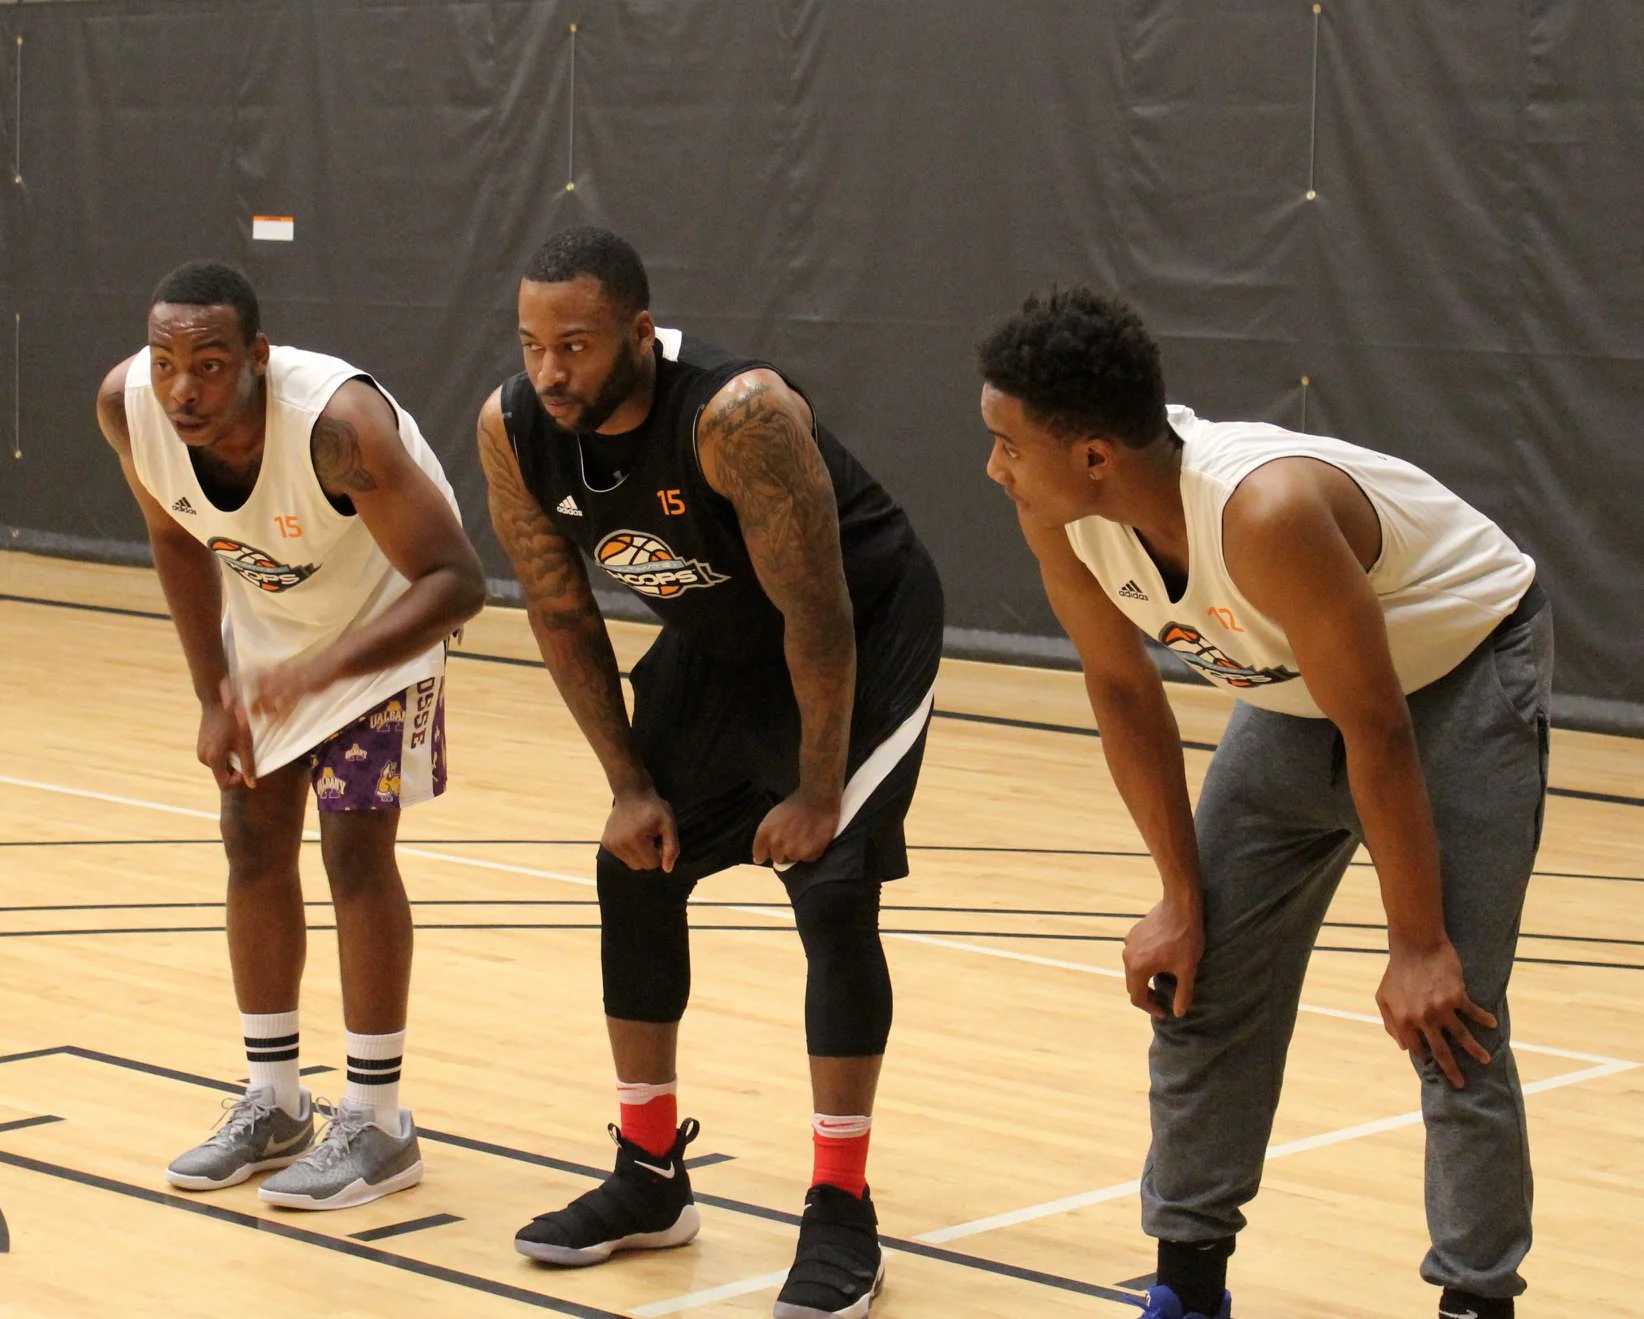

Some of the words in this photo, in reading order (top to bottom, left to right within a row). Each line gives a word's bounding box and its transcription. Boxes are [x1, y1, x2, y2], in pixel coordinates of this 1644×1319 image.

[172, 504, 197, 516] adidas
[556, 505, 583, 517] adidas
[656, 489, 686, 516] 15
[274, 516, 304, 538] 15
[1118, 589, 1149, 602] adidas
[1205, 606, 1245, 632] 12
